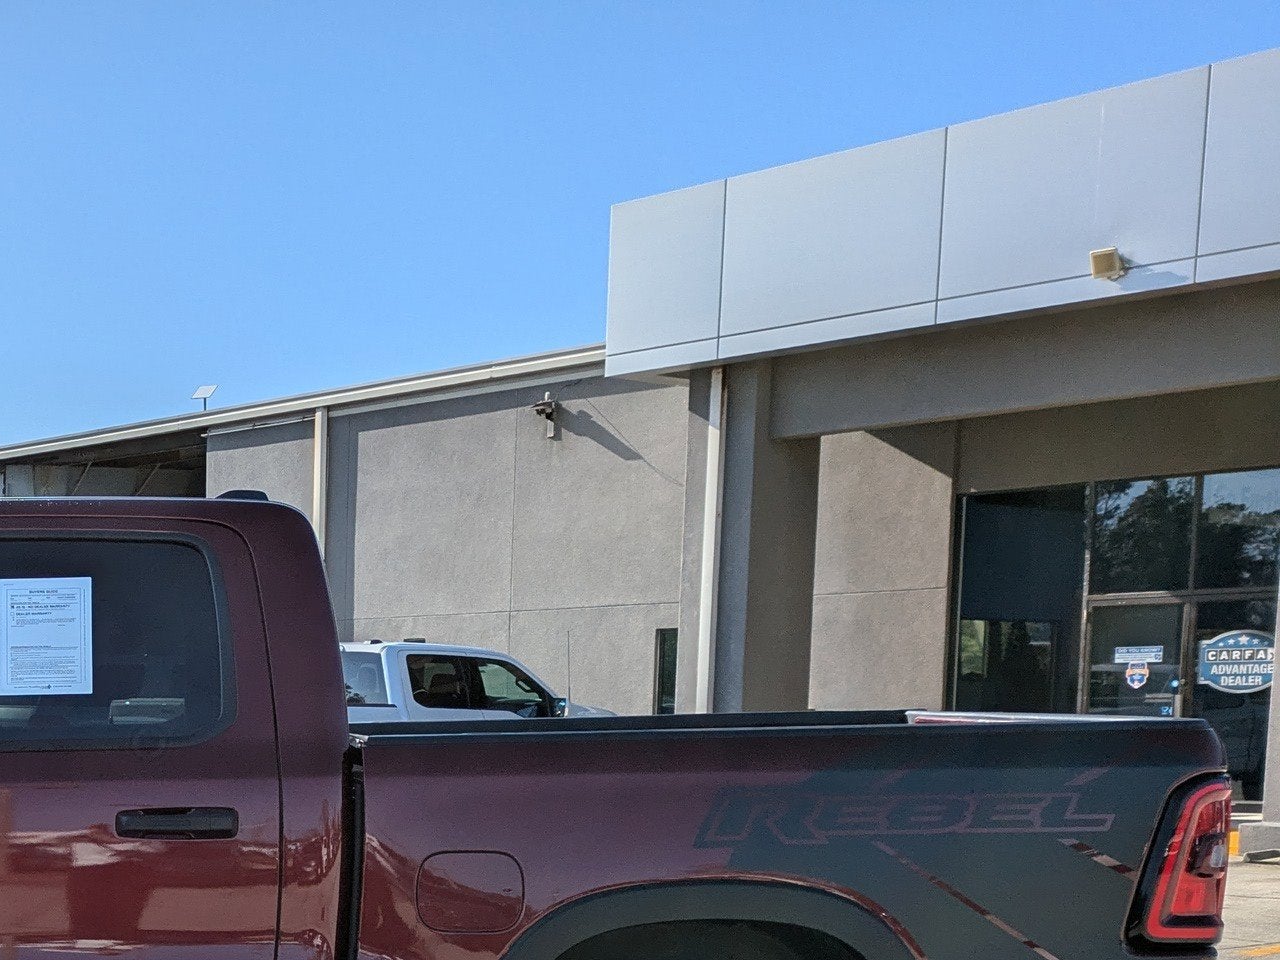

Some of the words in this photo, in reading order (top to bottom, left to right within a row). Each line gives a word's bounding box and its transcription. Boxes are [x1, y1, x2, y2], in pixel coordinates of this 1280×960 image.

[1210, 663, 1274, 675] ADVANTAGE
[1220, 675, 1262, 686] DEALER
[705, 792, 1116, 845] REBEL
